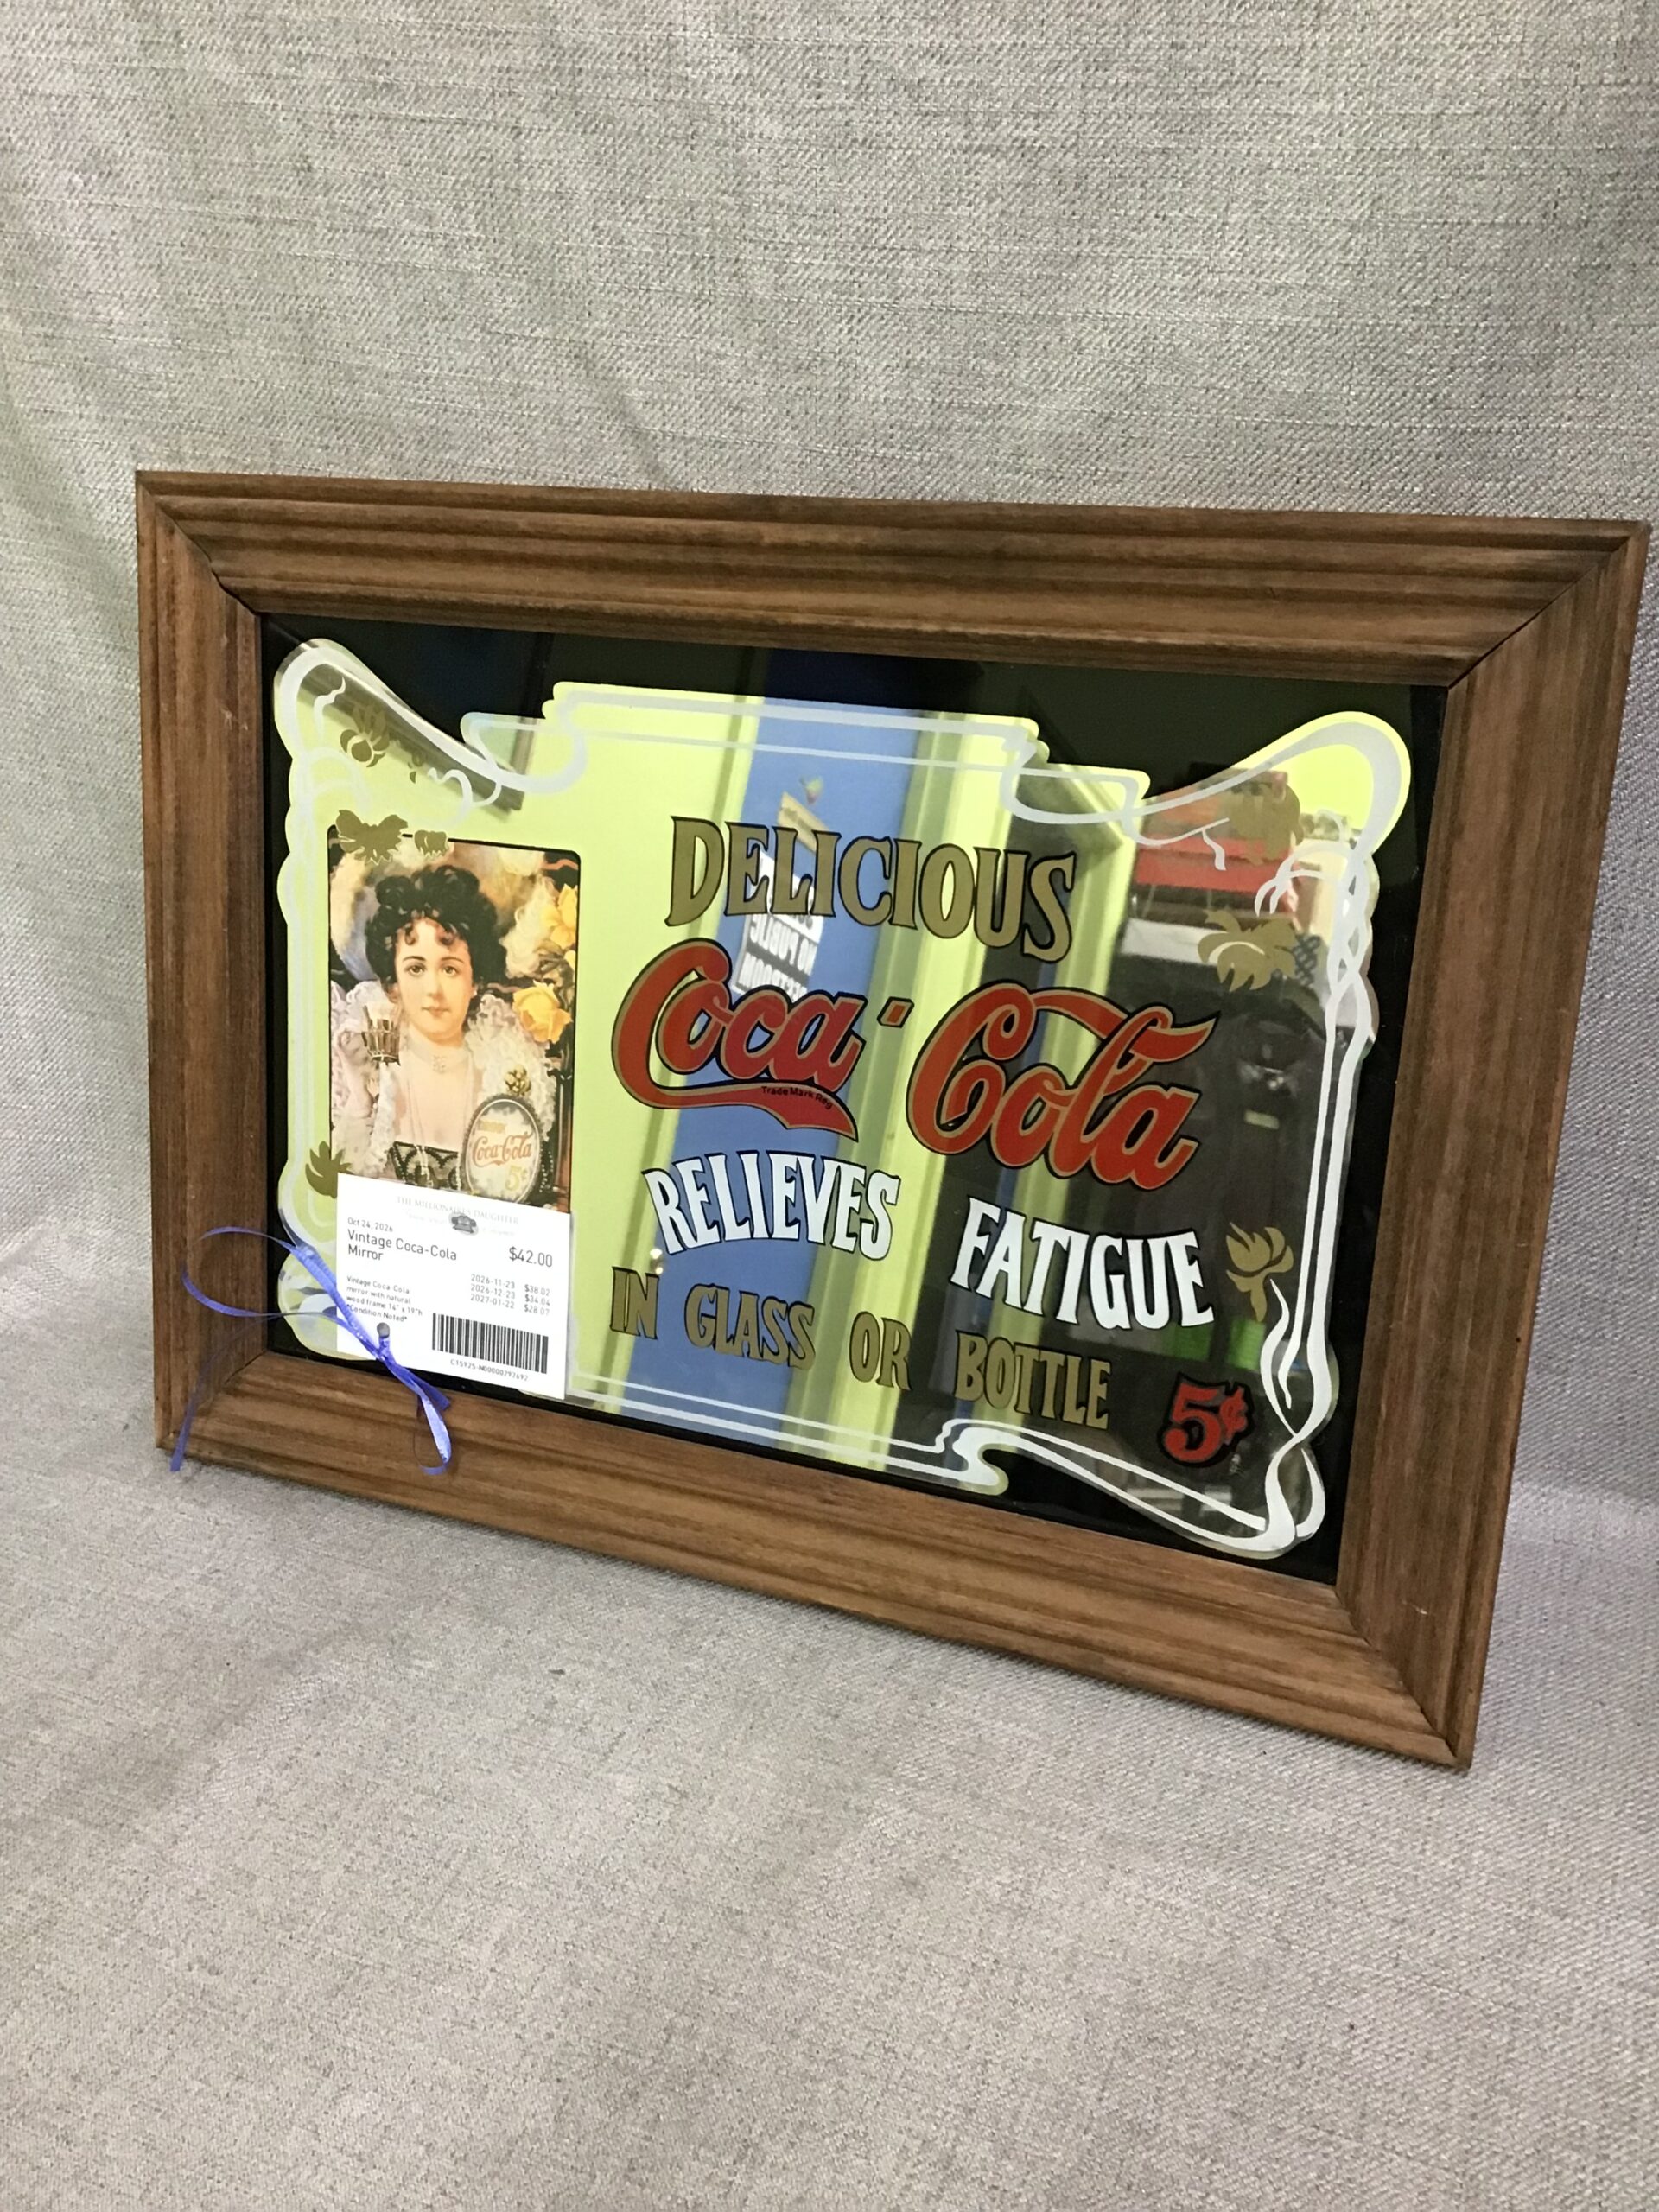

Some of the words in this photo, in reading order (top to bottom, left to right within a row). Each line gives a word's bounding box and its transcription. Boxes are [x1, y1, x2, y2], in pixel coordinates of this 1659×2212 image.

[665, 816, 1077, 963] DELICIOUS
[761, 1085, 789, 1096] Trade
[790, 1087, 813, 1098] Mark
[397, 1196, 412, 1206] THE
[474, 1209, 518, 1224] DAUGHTER
[347, 1217, 359, 1226] Oct
[375, 1222, 393, 1233] 2026
[347, 1229, 392, 1249] Vintage
[396, 1237, 457, 1261] Coca-Cola
[642, 1148, 901, 1261] RELIEVES
[950, 1196, 1213, 1331] FATIGUE
[348, 1243, 383, 1261] Mirror
[509, 1246, 553, 1268] $42.00
[346, 1275, 371, 1287] Vintage
[346, 1296, 365, 1305] wood
[386, 1294, 410, 1304] natural
[610, 1267, 659, 1340] IN
[684, 1282, 816, 1370] GLASS
[849, 1310, 913, 1390] OR
[955, 1329, 1111, 1429] BOTTLE
